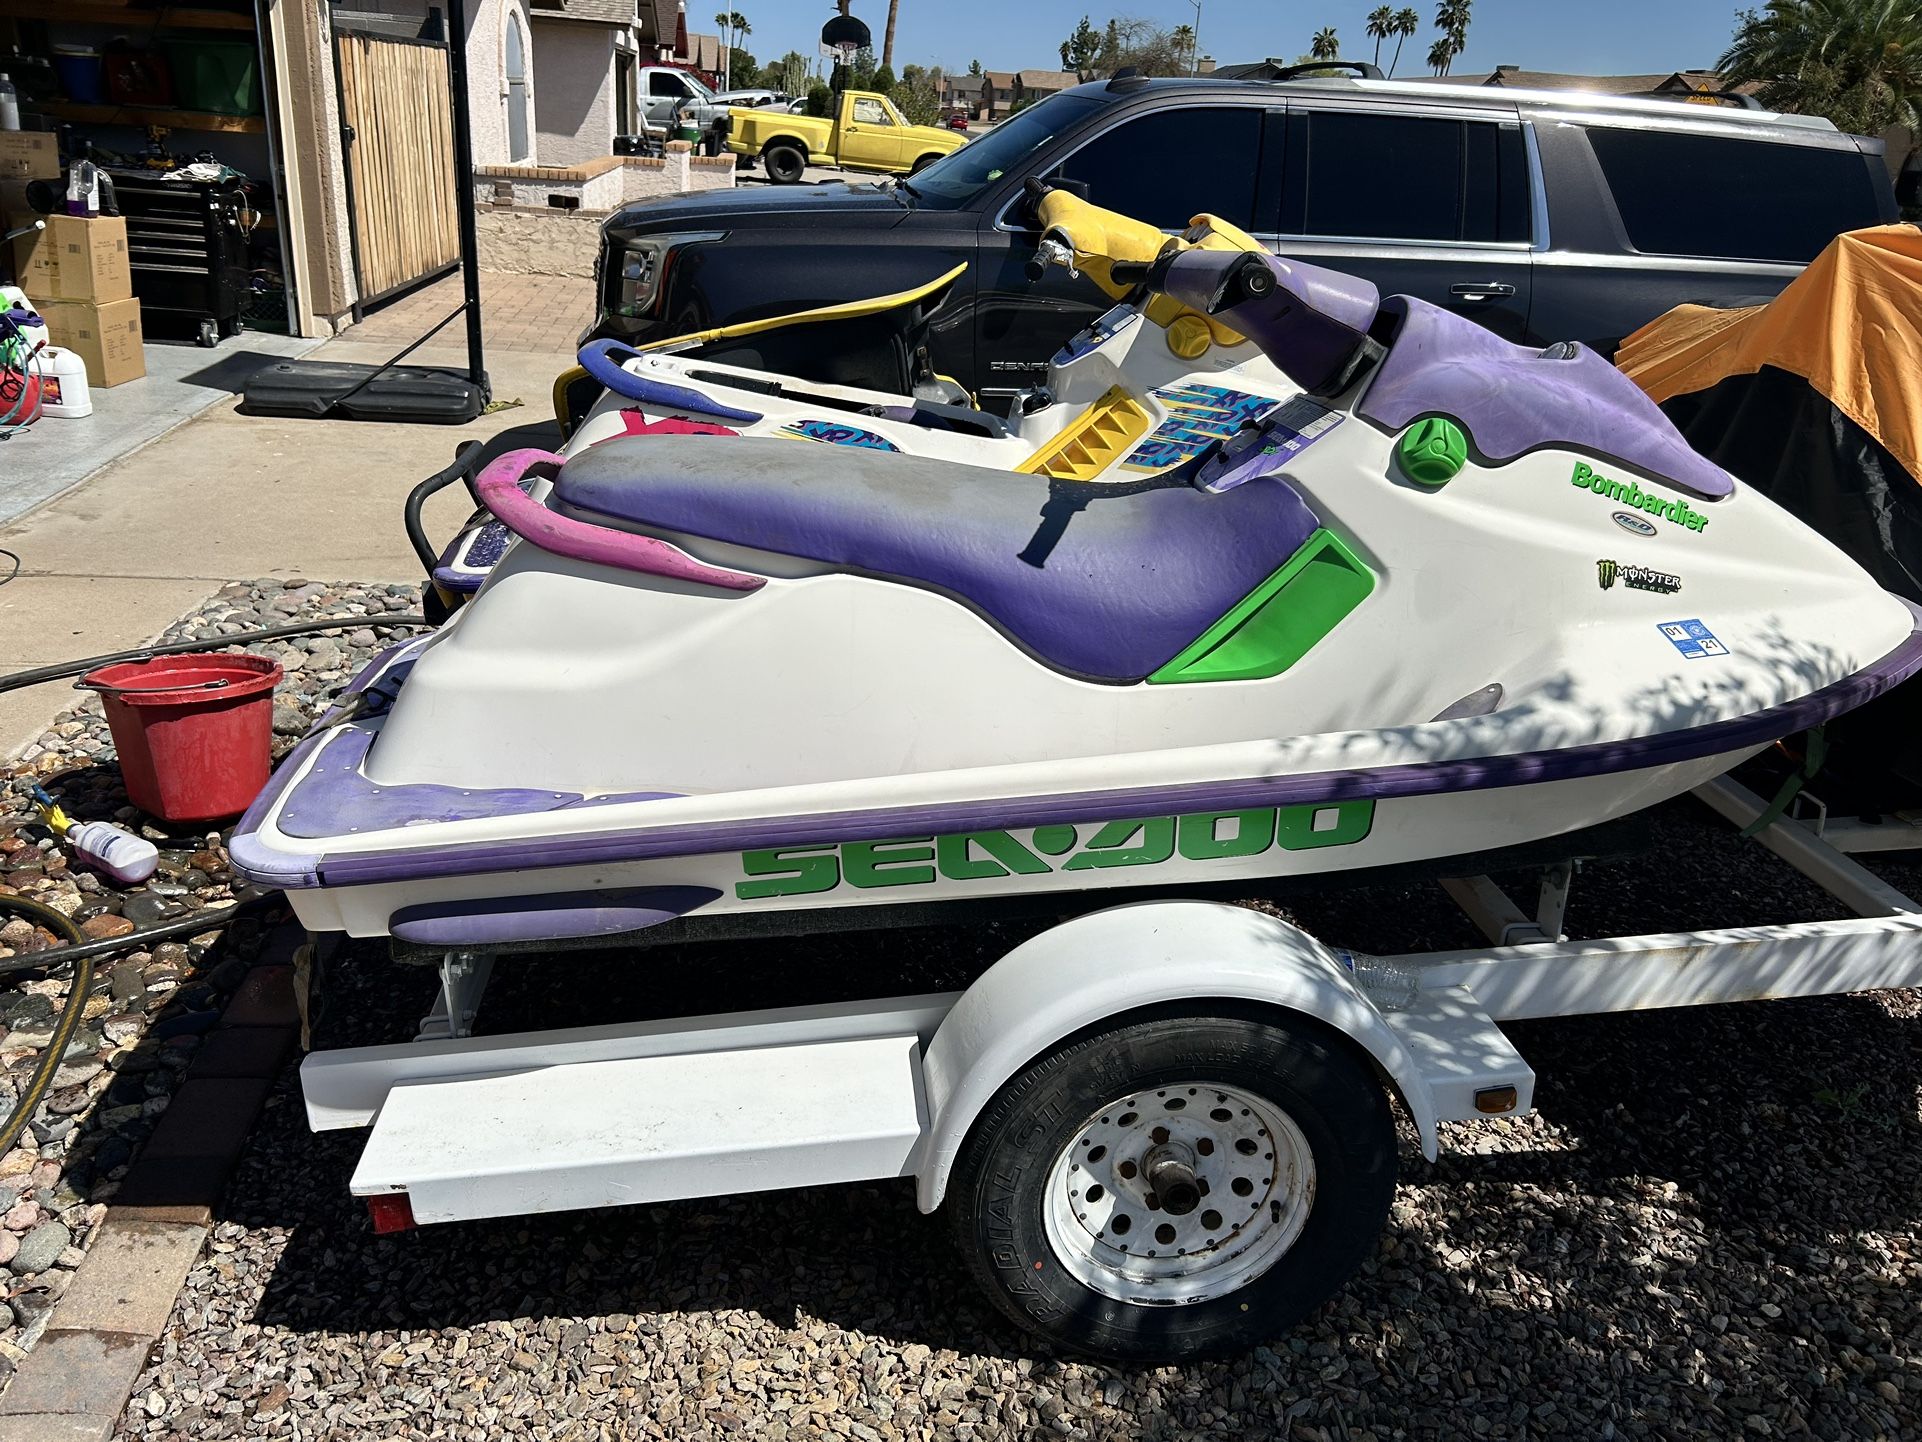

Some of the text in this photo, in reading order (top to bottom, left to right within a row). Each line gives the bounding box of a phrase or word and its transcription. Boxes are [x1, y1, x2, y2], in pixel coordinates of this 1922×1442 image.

[1571, 461, 1709, 533] Bombardier
[1616, 566, 1681, 589] MONSTER
[1625, 581, 1671, 594] ENERGY
[1665, 626, 1683, 636] 01
[1701, 639, 1718, 649] 21
[986, 1164, 1070, 1323] RADIAL
